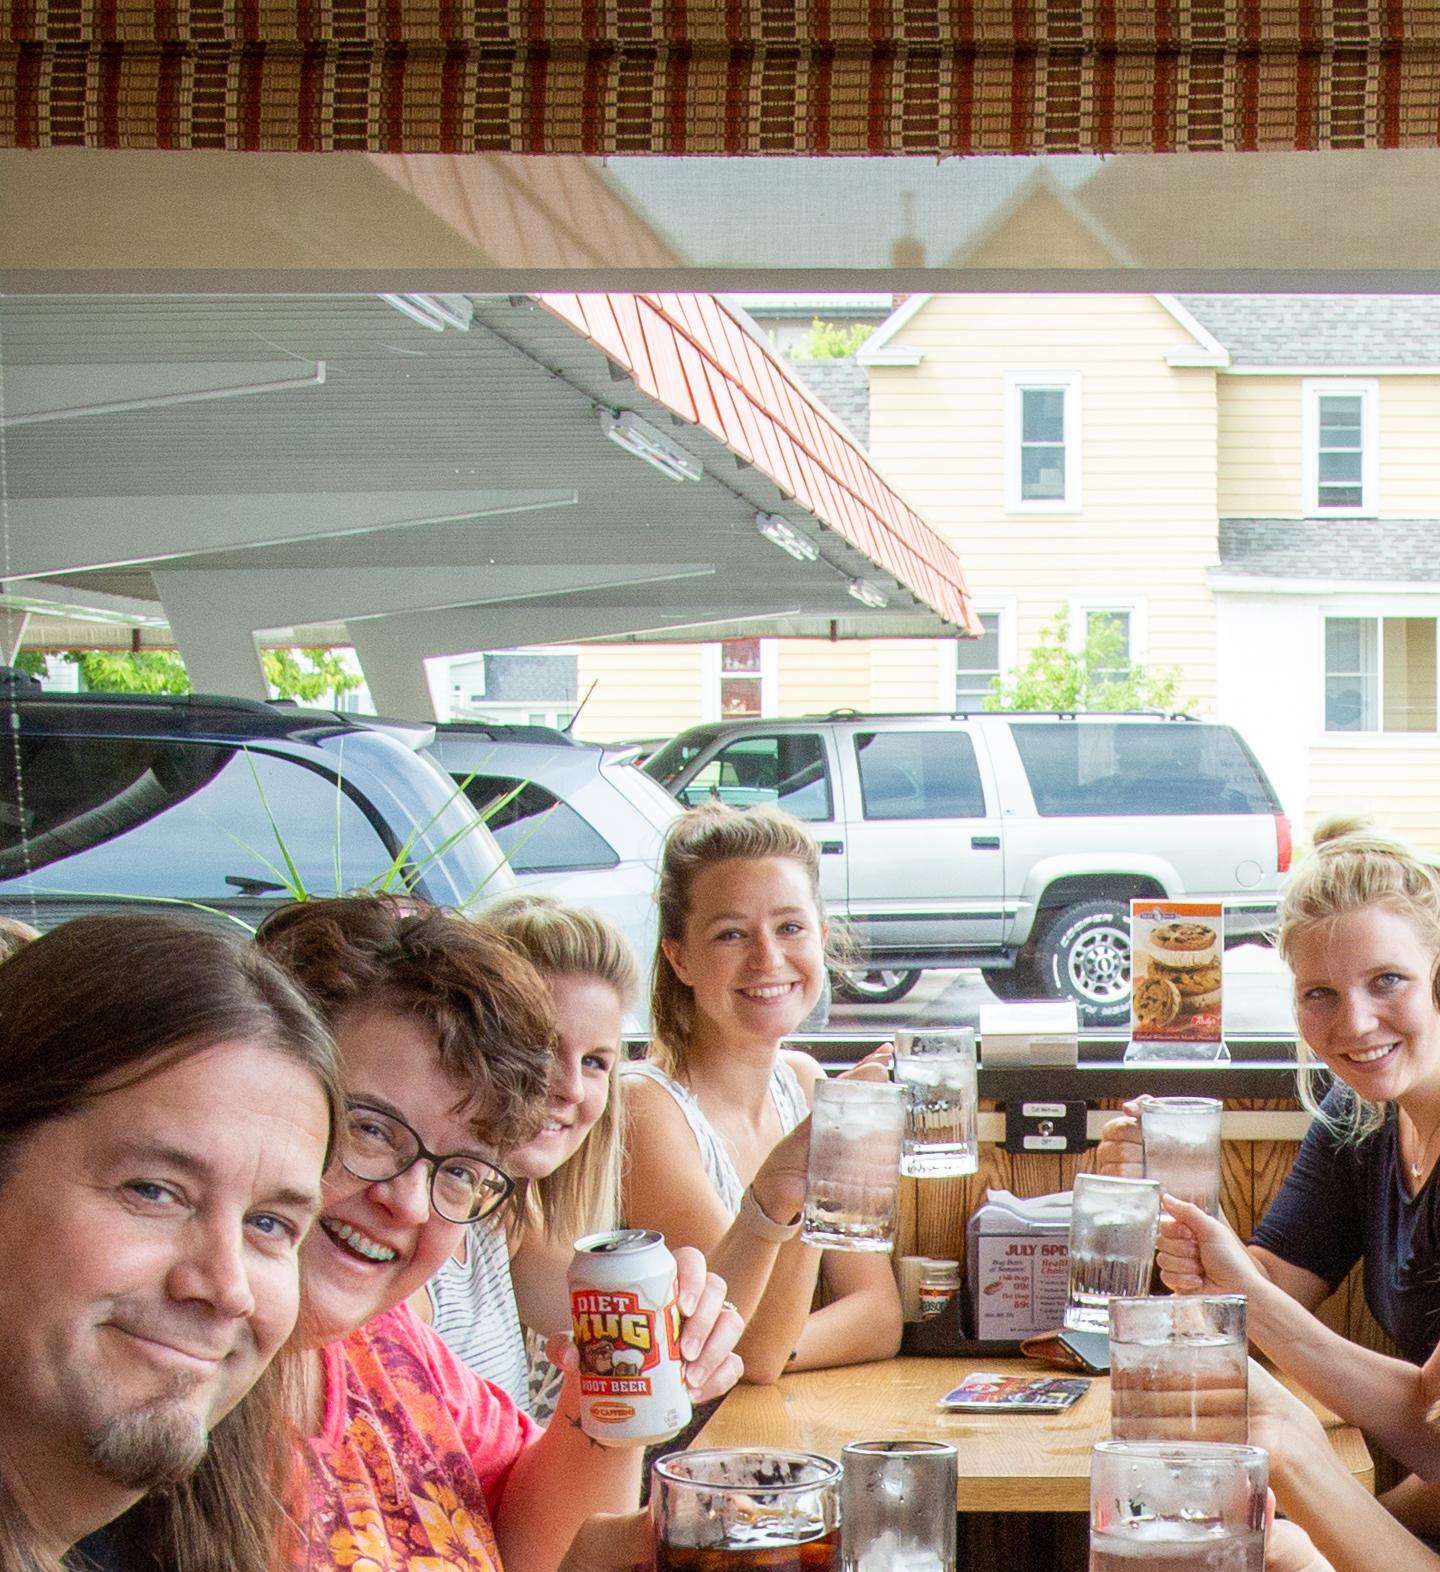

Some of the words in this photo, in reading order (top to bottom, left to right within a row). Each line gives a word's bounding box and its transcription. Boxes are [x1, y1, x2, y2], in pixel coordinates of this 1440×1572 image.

[1005, 1244, 1038, 1256] JULY
[578, 1296, 630, 1313] DIET
[611, 1380, 647, 1393] BEER
